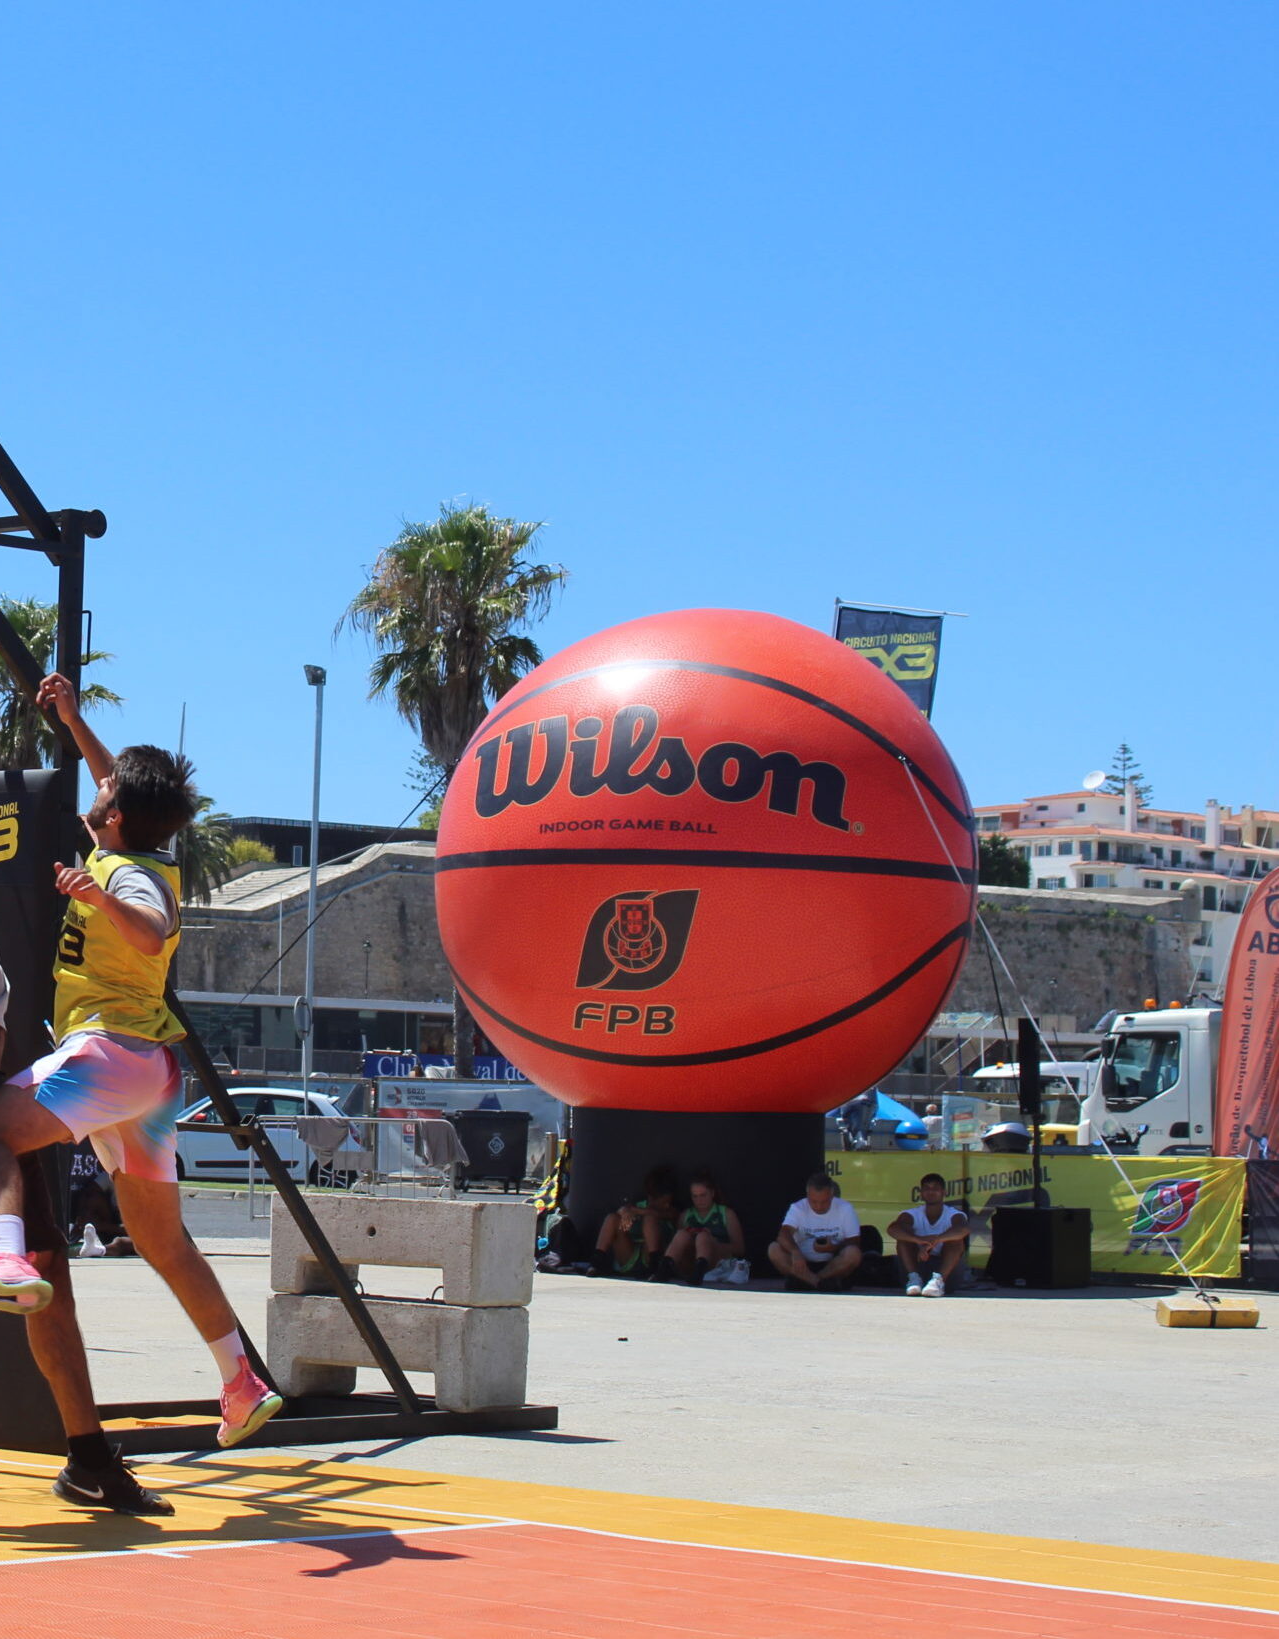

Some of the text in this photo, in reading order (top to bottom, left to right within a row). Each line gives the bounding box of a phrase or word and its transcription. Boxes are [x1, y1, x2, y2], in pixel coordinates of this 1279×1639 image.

[843, 631, 937, 648] CIRCUITO NACIONAL
[474, 705, 851, 833] Wilson
[540, 819, 717, 834] INDOOR GAME BALL
[1243, 958, 1258, 1000] Lisboa
[572, 1001, 677, 1036] FPB
[1241, 1004, 1253, 1020] de
[1233, 1024, 1252, 1101] Basquetebol
[1231, 1105, 1242, 1120] de
